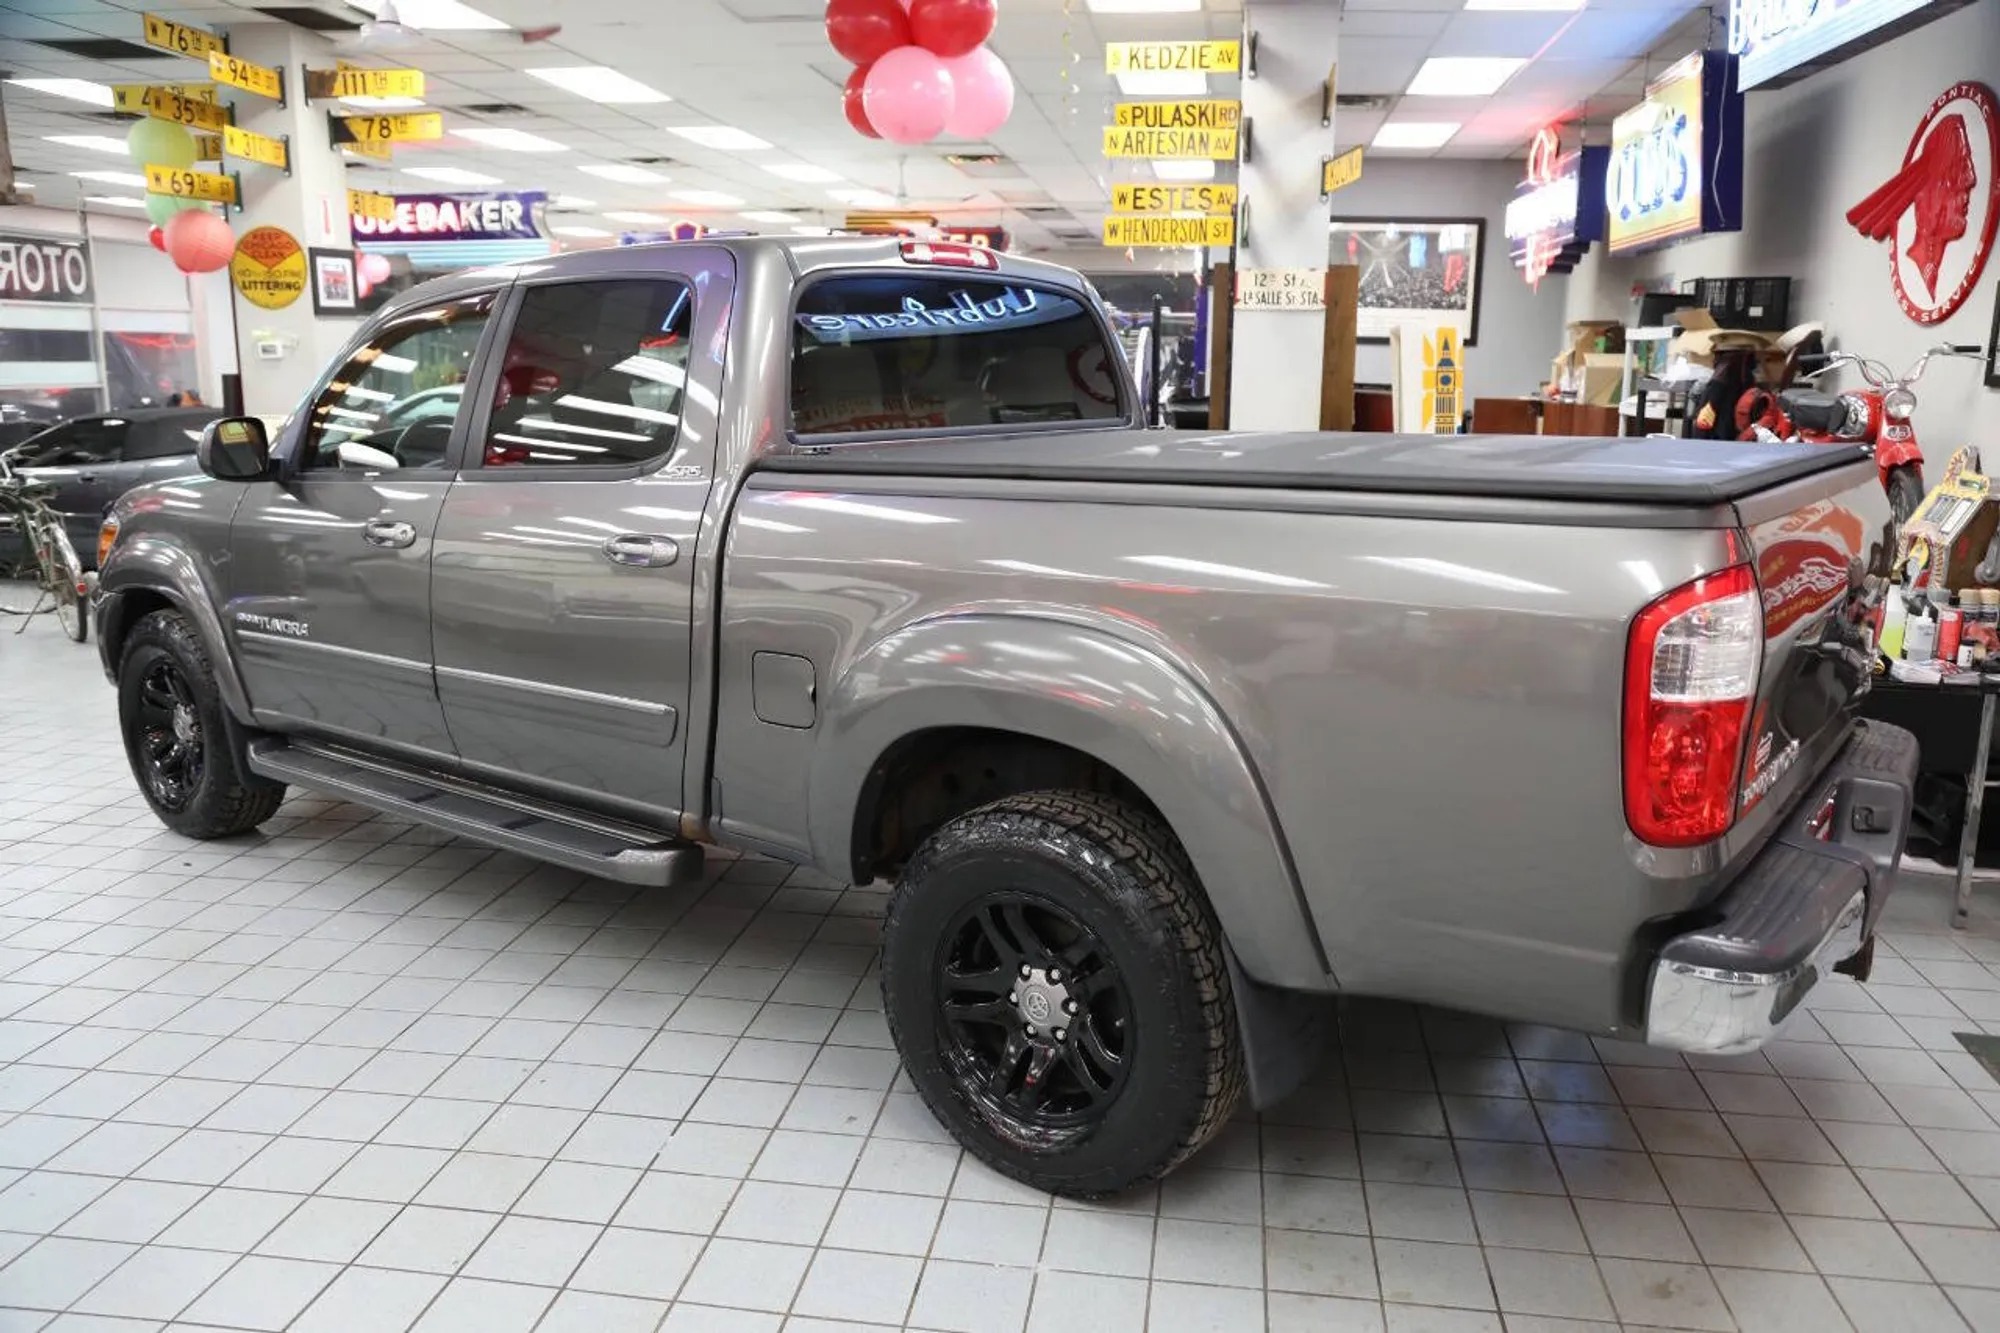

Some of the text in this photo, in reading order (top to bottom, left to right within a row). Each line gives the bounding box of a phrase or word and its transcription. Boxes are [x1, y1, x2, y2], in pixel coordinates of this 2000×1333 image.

[164, 23, 201, 51] 76TH
[1129, 44, 1212, 70] KEDZIE
[1217, 50, 1234, 65] AV
[342, 71, 413, 96] 111TH ST
[116, 90, 126, 105] W
[1926, 85, 1991, 121] PONTIAC
[362, 116, 409, 139] 78TH
[1120, 103, 1237, 128] S PULASKI RD
[1109, 131, 1232, 156] N ARTESIAN AV
[171, 172, 209, 195] 69TH
[1118, 187, 1234, 210] W ESTES AV
[1108, 218, 1230, 243] W HENDERSON ST
[242, 279, 301, 291] LITTERING
[1921, 241, 1984, 322] SERVICE
[259, 615, 310, 637] TUNDRA
